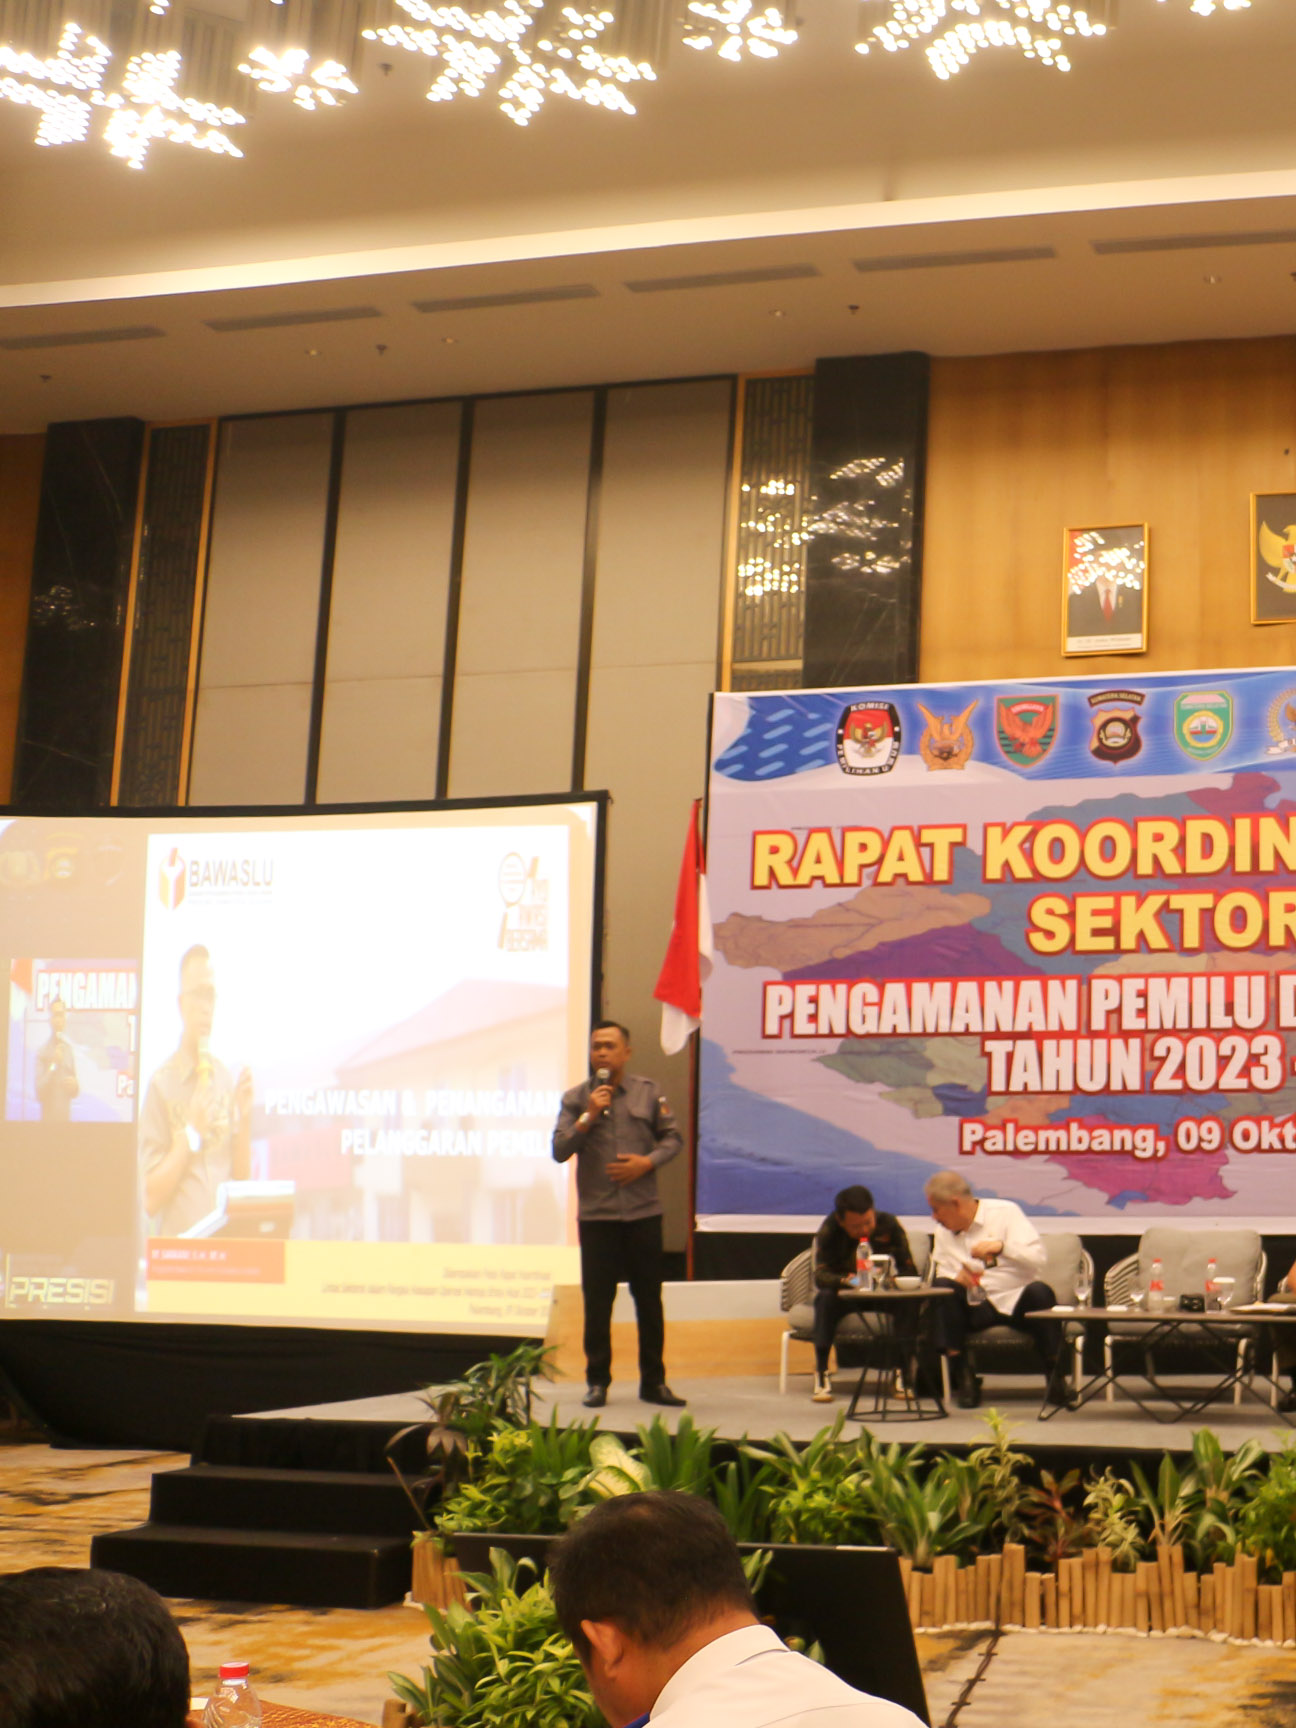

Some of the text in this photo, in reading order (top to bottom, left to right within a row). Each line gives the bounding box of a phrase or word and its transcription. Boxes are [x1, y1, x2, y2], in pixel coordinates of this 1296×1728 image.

[850, 702, 889, 712] KOMISI
[752, 825, 966, 888] RAPAT
[188, 858, 274, 887] BAWASLU
[764, 976, 1081, 1037] PENGAMANAN
[1089, 971, 1270, 1033] PEMILU
[983, 1037, 1144, 1094] TAHUN
[1151, 1032, 1284, 1093] 2023
[265, 1090, 396, 1115] PENGAWASAN
[340, 1128, 483, 1156] PELANGGARAN
[960, 1119, 1167, 1160] Palembang,
[1174, 1119, 1224, 1153] 09
[10, 1276, 115, 1305] PRESISI
